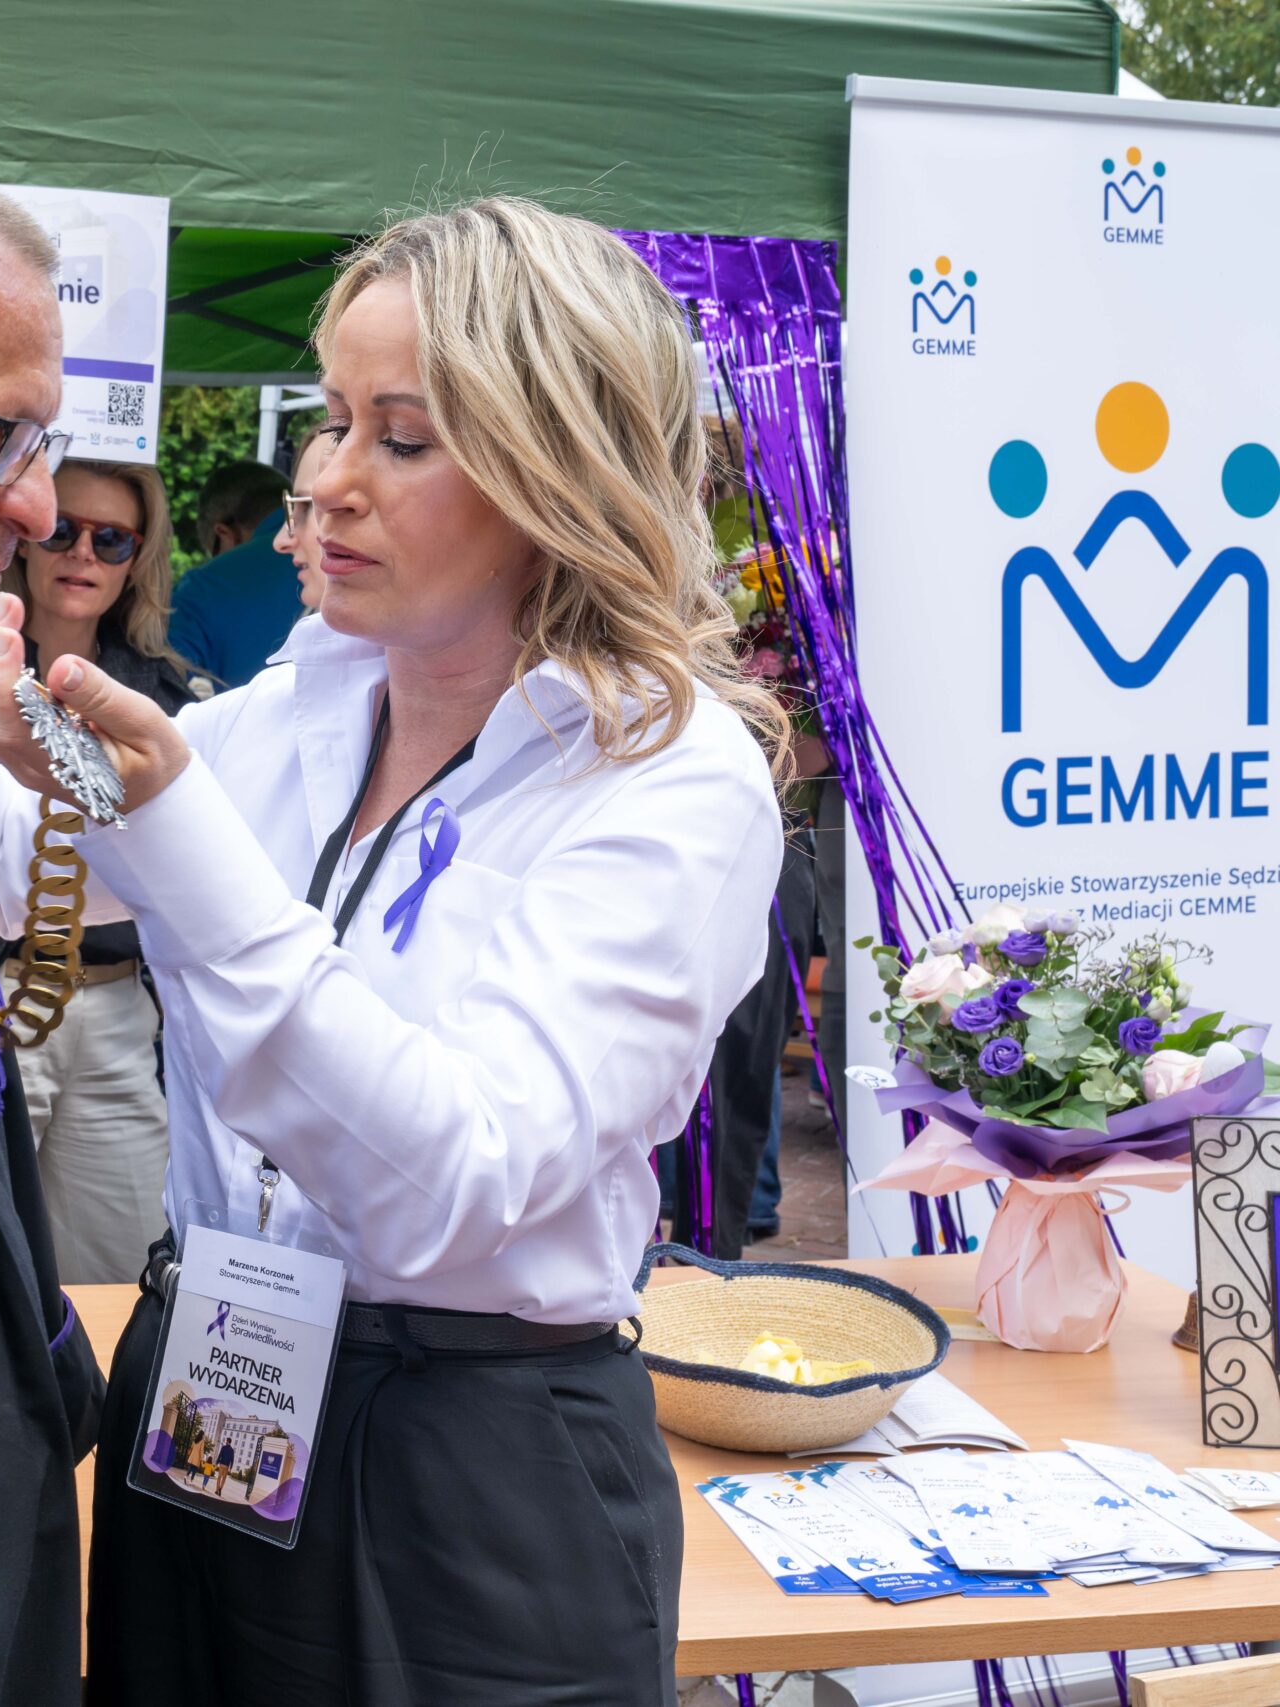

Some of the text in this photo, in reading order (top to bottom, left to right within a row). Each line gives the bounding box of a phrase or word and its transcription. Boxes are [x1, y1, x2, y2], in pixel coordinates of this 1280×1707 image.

[1103, 226, 1164, 245] GEMME
[912, 338, 976, 356] GEMME
[1001, 750, 1269, 828] GEMME
[954, 876, 1064, 902] Europejskie
[1070, 867, 1221, 894] Stowarzyszenie
[1092, 899, 1172, 923] Mediacji
[1179, 895, 1257, 917] GEMME
[219, 1268, 300, 1296] Stowarzyszenie Gemme
[228, 1258, 295, 1282] Marzena Korzonek
[230, 1323, 295, 1353] Sprawiedliwości
[231, 1314, 277, 1335] Dzień Wymiaru
[209, 1346, 282, 1386] PARTNER
[189, 1361, 295, 1415] WYDARZENIA
